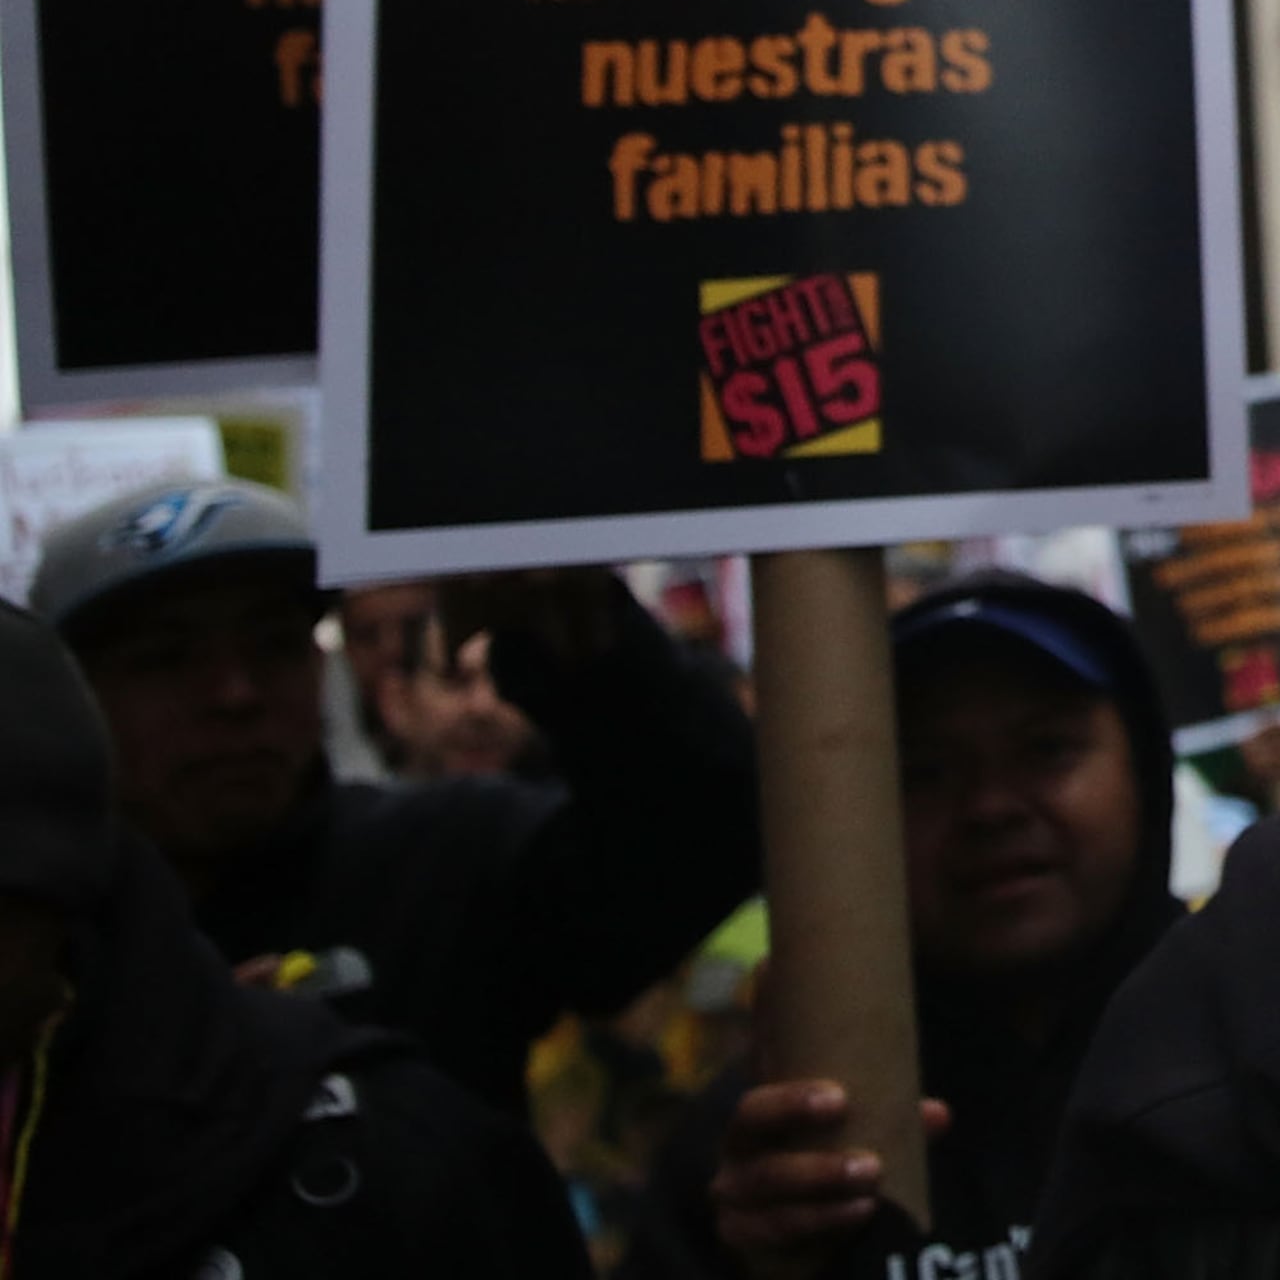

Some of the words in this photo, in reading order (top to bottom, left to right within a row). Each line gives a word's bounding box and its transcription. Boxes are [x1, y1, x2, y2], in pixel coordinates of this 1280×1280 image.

[581, 12, 994, 108] nuestras
[607, 121, 969, 222] familias
[700, 276, 838, 378] FIGHT
